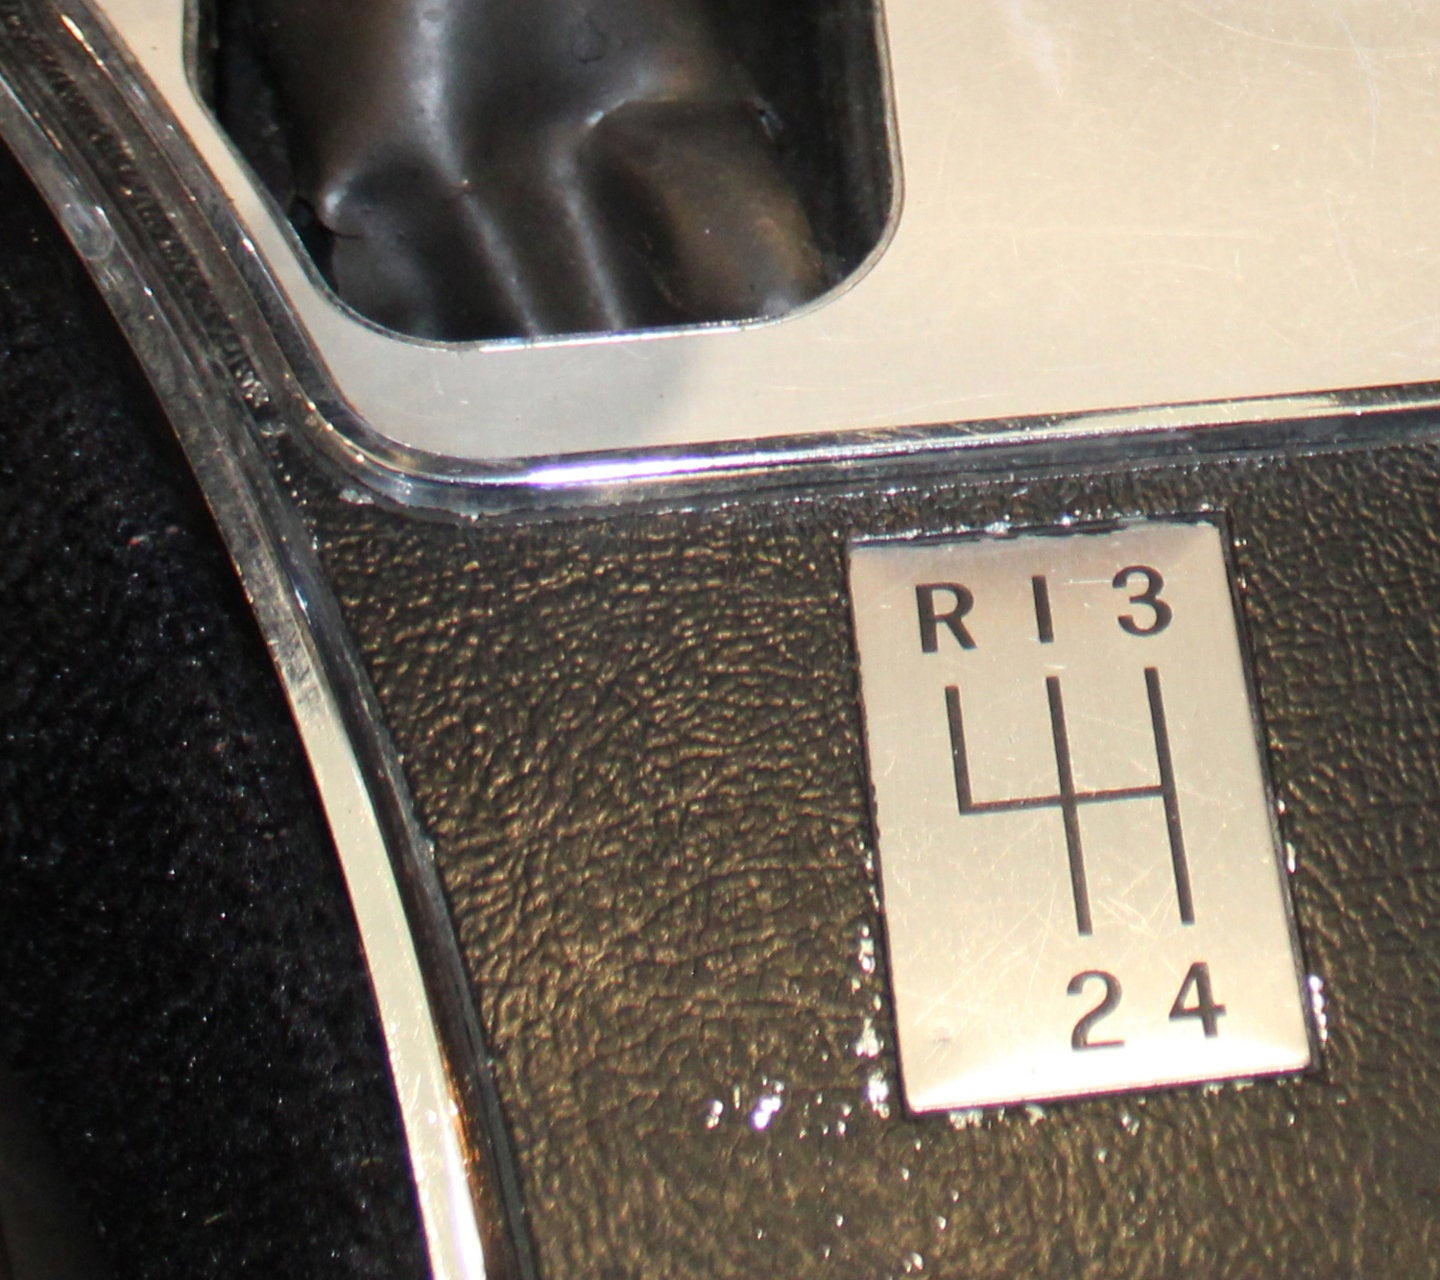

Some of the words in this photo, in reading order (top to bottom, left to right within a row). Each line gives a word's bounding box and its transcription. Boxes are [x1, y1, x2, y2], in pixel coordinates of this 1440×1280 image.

[914, 580, 978, 654] R
[1110, 564, 1174, 638] 3
[1065, 969, 1127, 1053] 2
[1167, 960, 1228, 1040] 4
